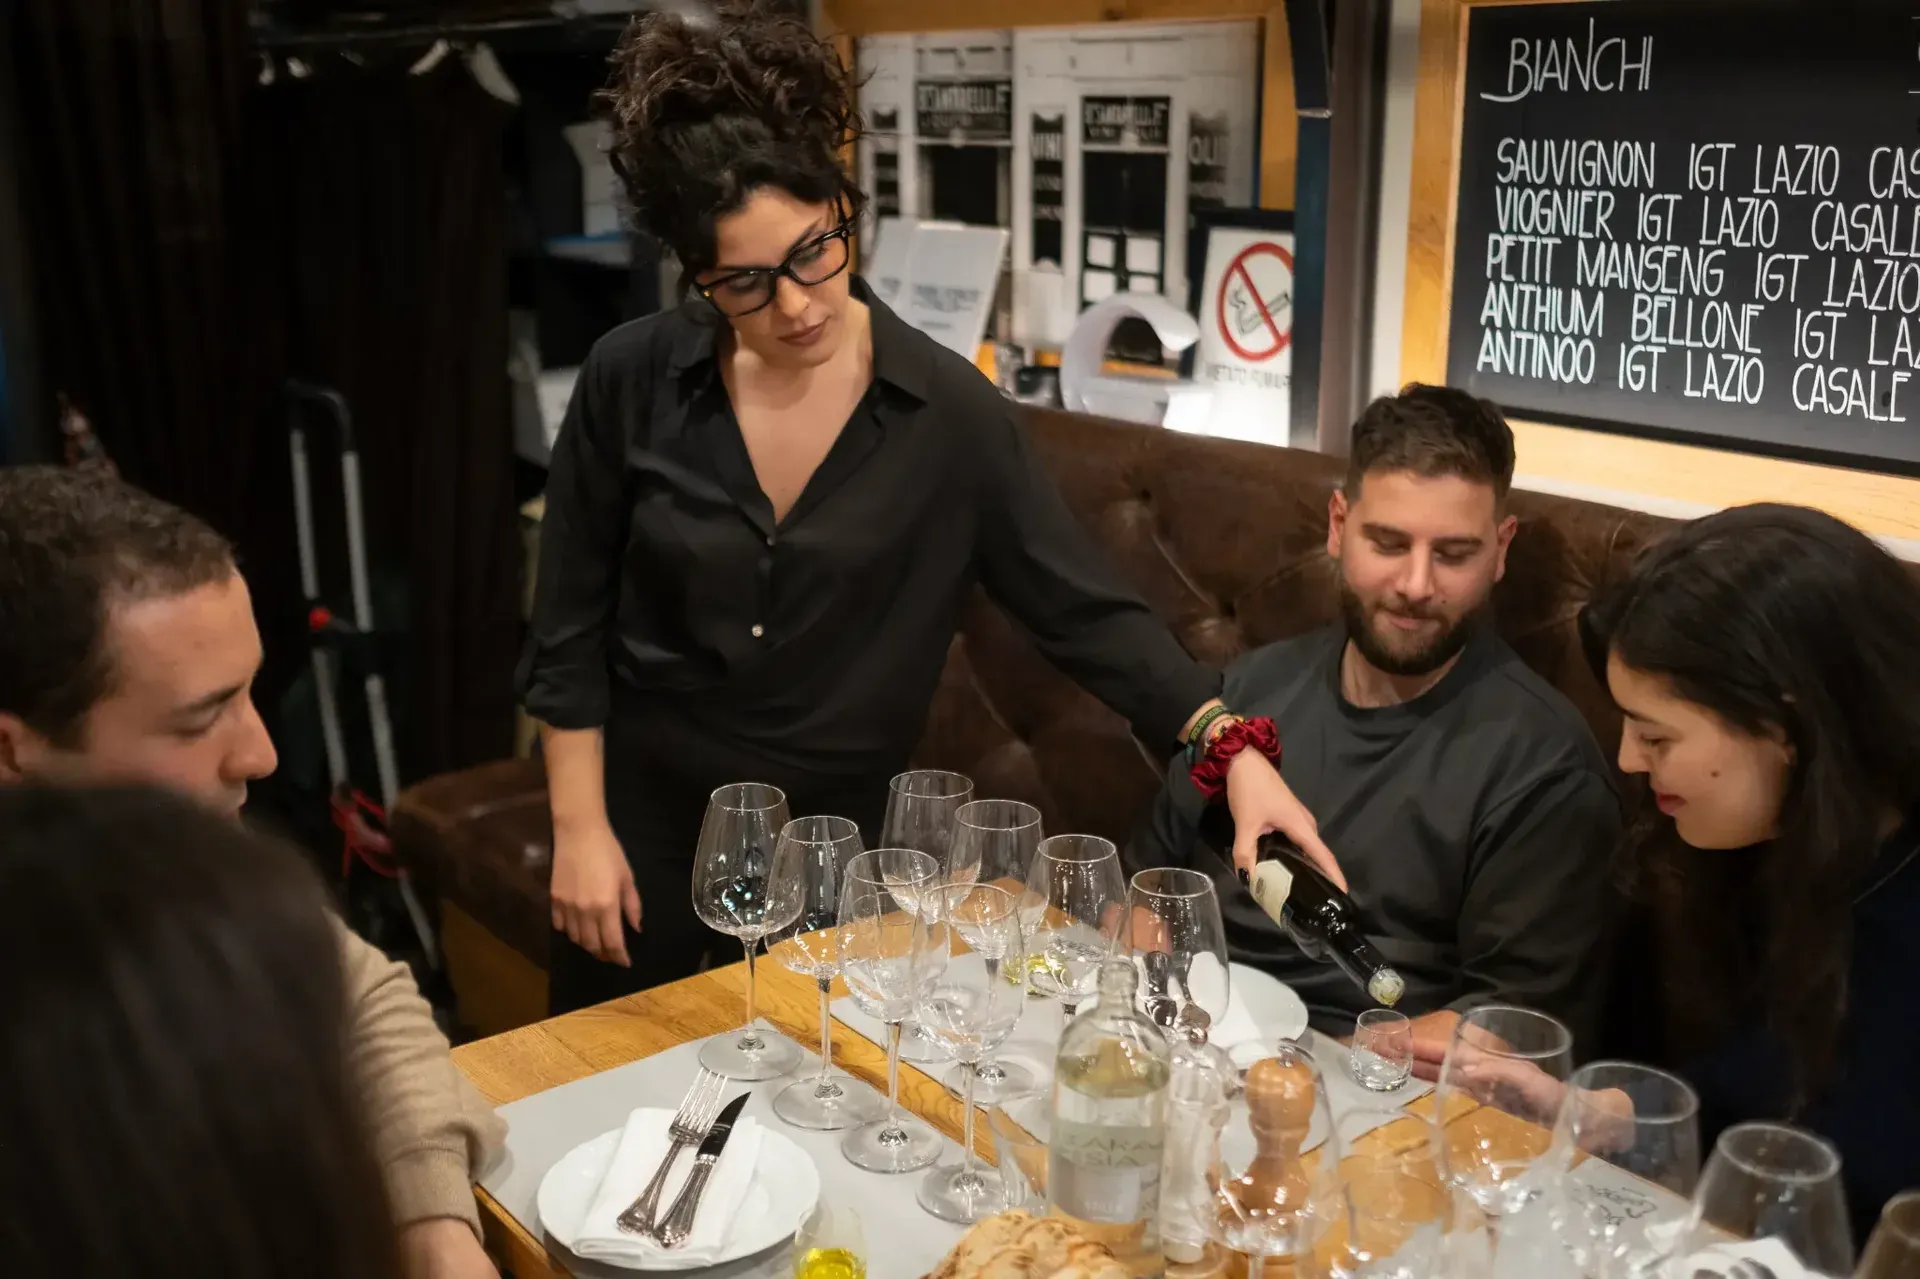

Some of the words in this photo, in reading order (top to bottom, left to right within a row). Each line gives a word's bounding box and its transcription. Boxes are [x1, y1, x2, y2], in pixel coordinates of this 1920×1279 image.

[1479, 17, 1654, 102] BIANCHI
[1496, 137, 1656, 189] SAUVIGNON
[1688, 142, 1737, 192] IGT
[1752, 143, 1840, 198] LAZIO
[1495, 185, 1616, 241] VIOGNIER
[1636, 192, 1683, 243] IGT
[1698, 195, 1780, 249] LAZIO
[1485, 232, 1562, 285] PETIT
[1576, 239, 1728, 298] MANSENG
[1754, 251, 1810, 303] IGT
[1822, 256, 1920, 314] LAZIO
[1479, 280, 1604, 338] ANTHIUM
[1630, 292, 1765, 355] BELLONE
[1793, 307, 1848, 361] IGT
[1476, 327, 1596, 385] ANTINOO
[1618, 341, 1667, 393] IGT
[1683, 349, 1765, 404] LAZIO
[1792, 362, 1912, 423] CASALE
